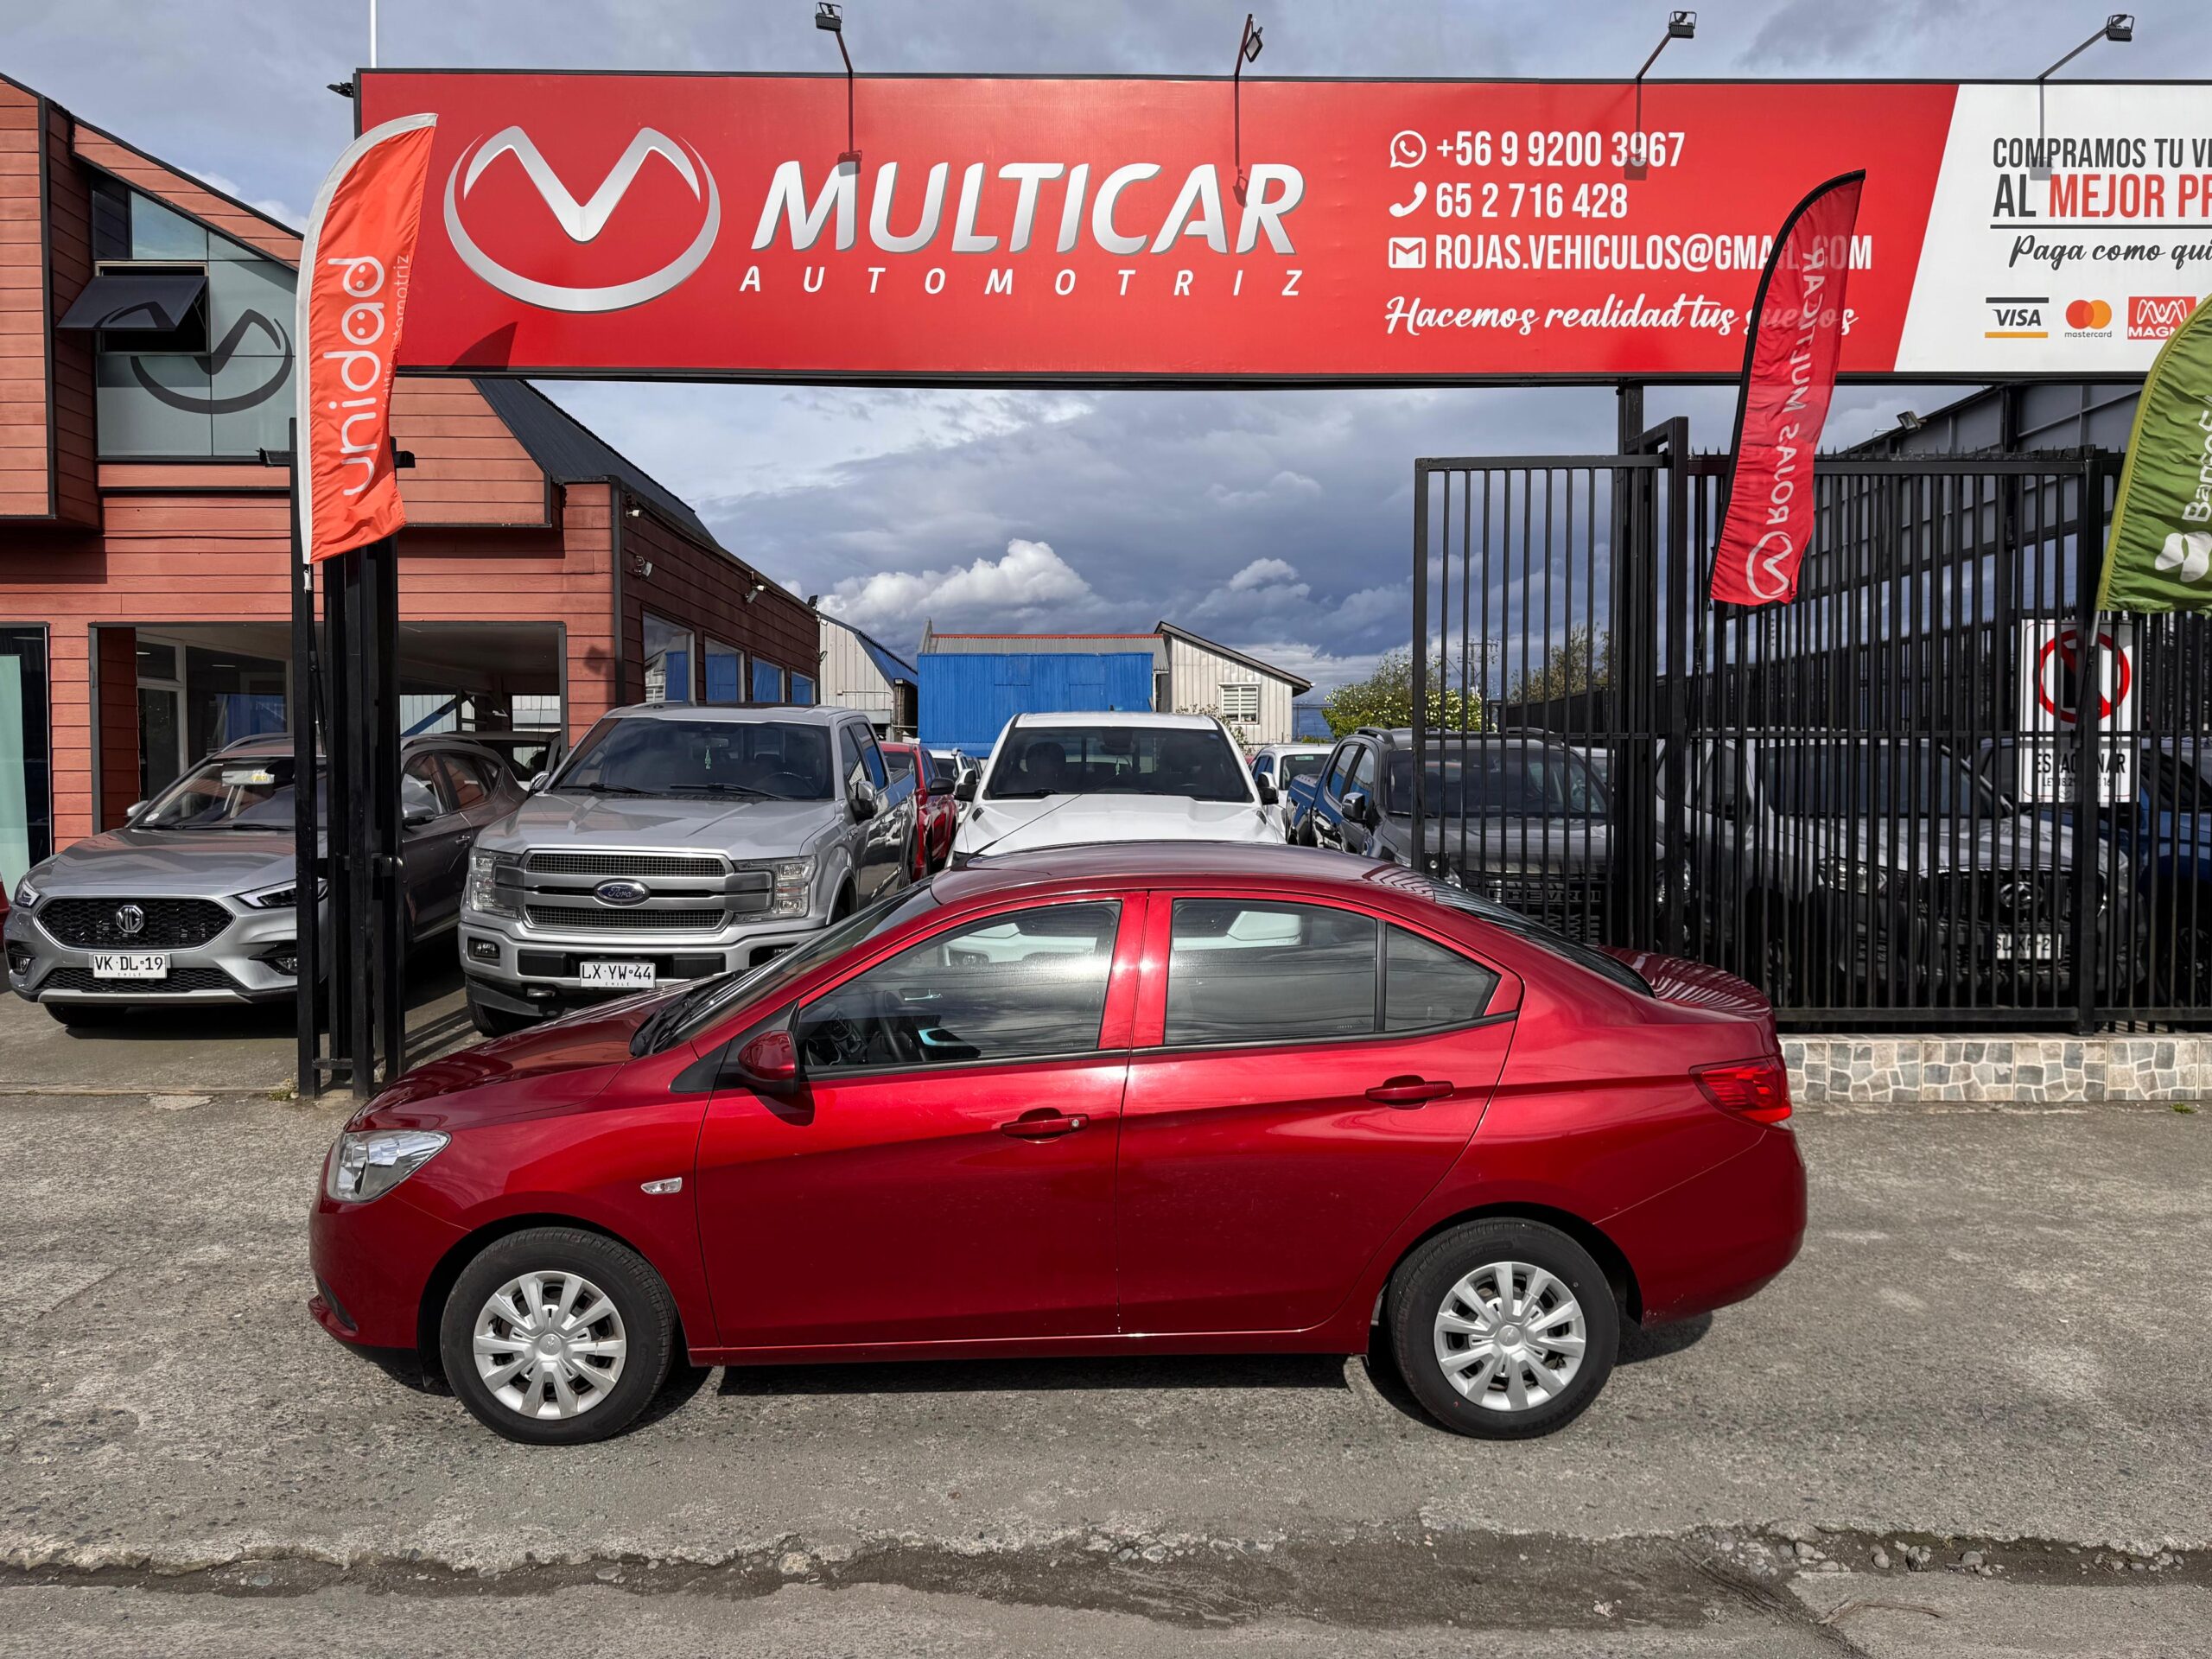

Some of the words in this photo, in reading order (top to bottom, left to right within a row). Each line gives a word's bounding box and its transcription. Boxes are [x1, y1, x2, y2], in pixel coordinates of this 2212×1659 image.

[1436, 130, 1491, 167] +56
[1501, 130, 1518, 167] 9
[1528, 130, 1602, 167] 9200
[1611, 131, 1685, 168] 3967
[1993, 137, 2146, 168] COMPRAMOS
[2153, 137, 2183, 168] TU
[749, 160, 1306, 257] MULTICAR
[1435, 182, 1472, 219] 65
[1481, 182, 1498, 218] 2
[1508, 182, 1564, 219] 716
[1572, 182, 1628, 219] 428
[1993, 174, 2037, 218] AL
[2049, 173, 2165, 218] MEJOR
[2008, 234, 2087, 271] Paga
[2091, 244, 2166, 261] como
[740, 265, 1303, 296] AUTOMOTRIZ
[1384, 295, 1540, 336] Hacemos
[1544, 293, 1685, 328] realidad
[1675, 293, 1739, 336] tus
[1992, 308, 2042, 327] VISA
[2064, 329, 2113, 339] mastercard
[322, 255, 385, 497] unidad
[607, 885, 634, 899] Ford
[118, 907, 142, 931] MG
